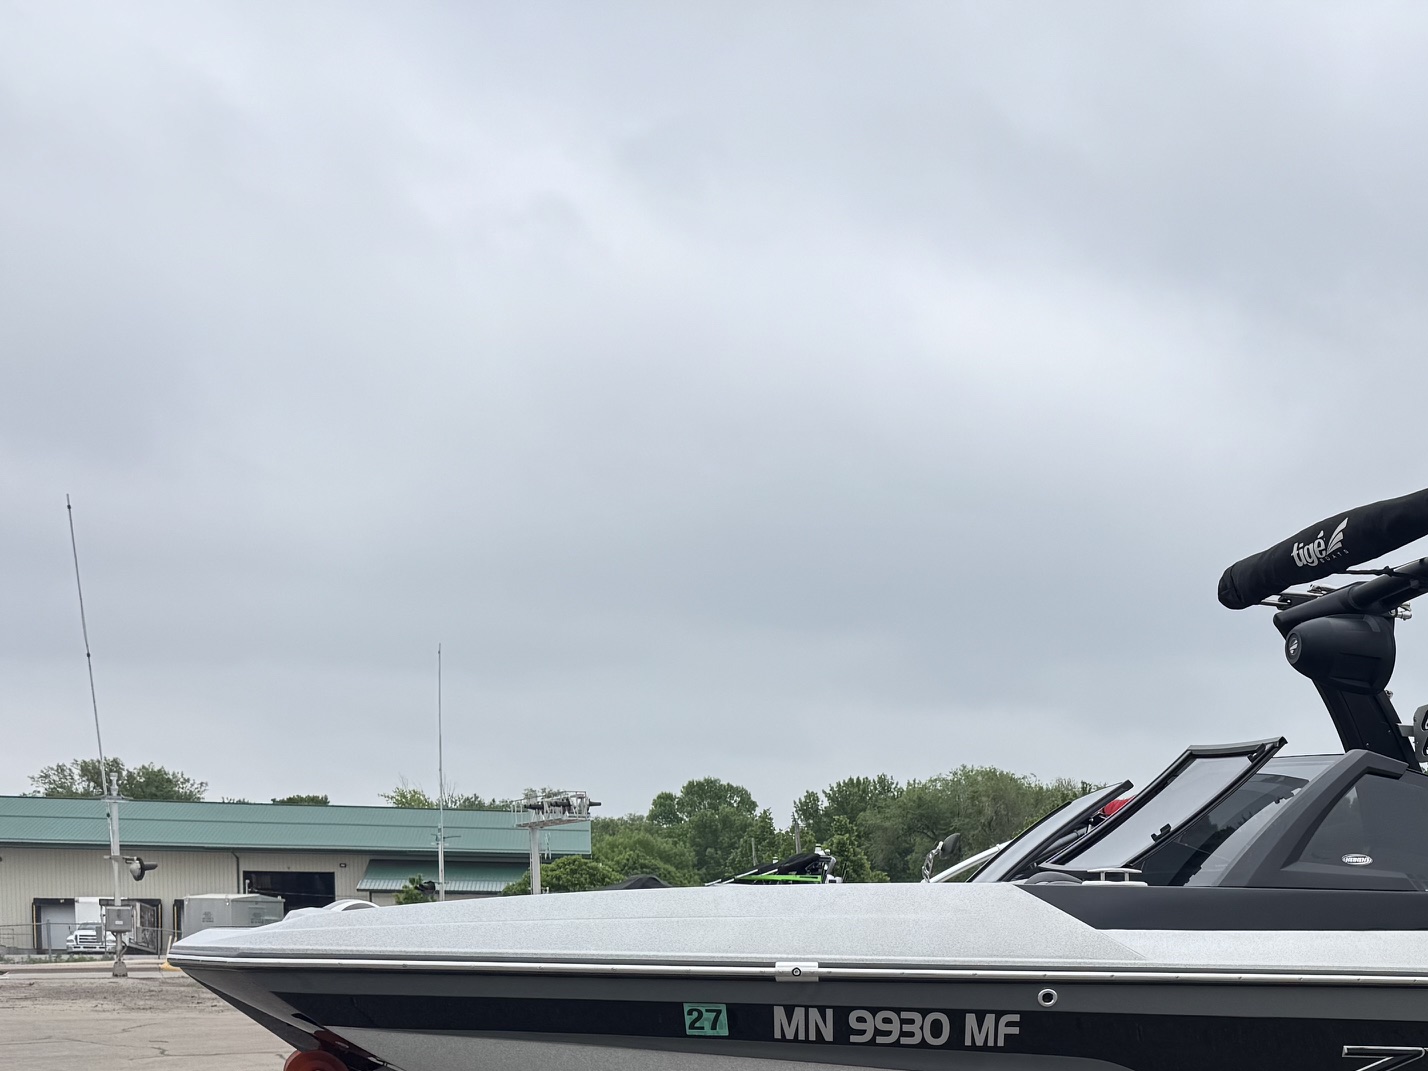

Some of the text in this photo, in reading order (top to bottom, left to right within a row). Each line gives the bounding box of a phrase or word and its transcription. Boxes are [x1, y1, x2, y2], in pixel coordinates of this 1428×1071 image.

[1290, 530, 1326, 567] tigé
[686, 1007, 722, 1031] 27
[773, 1005, 1021, 1047] MN 9930 MF
